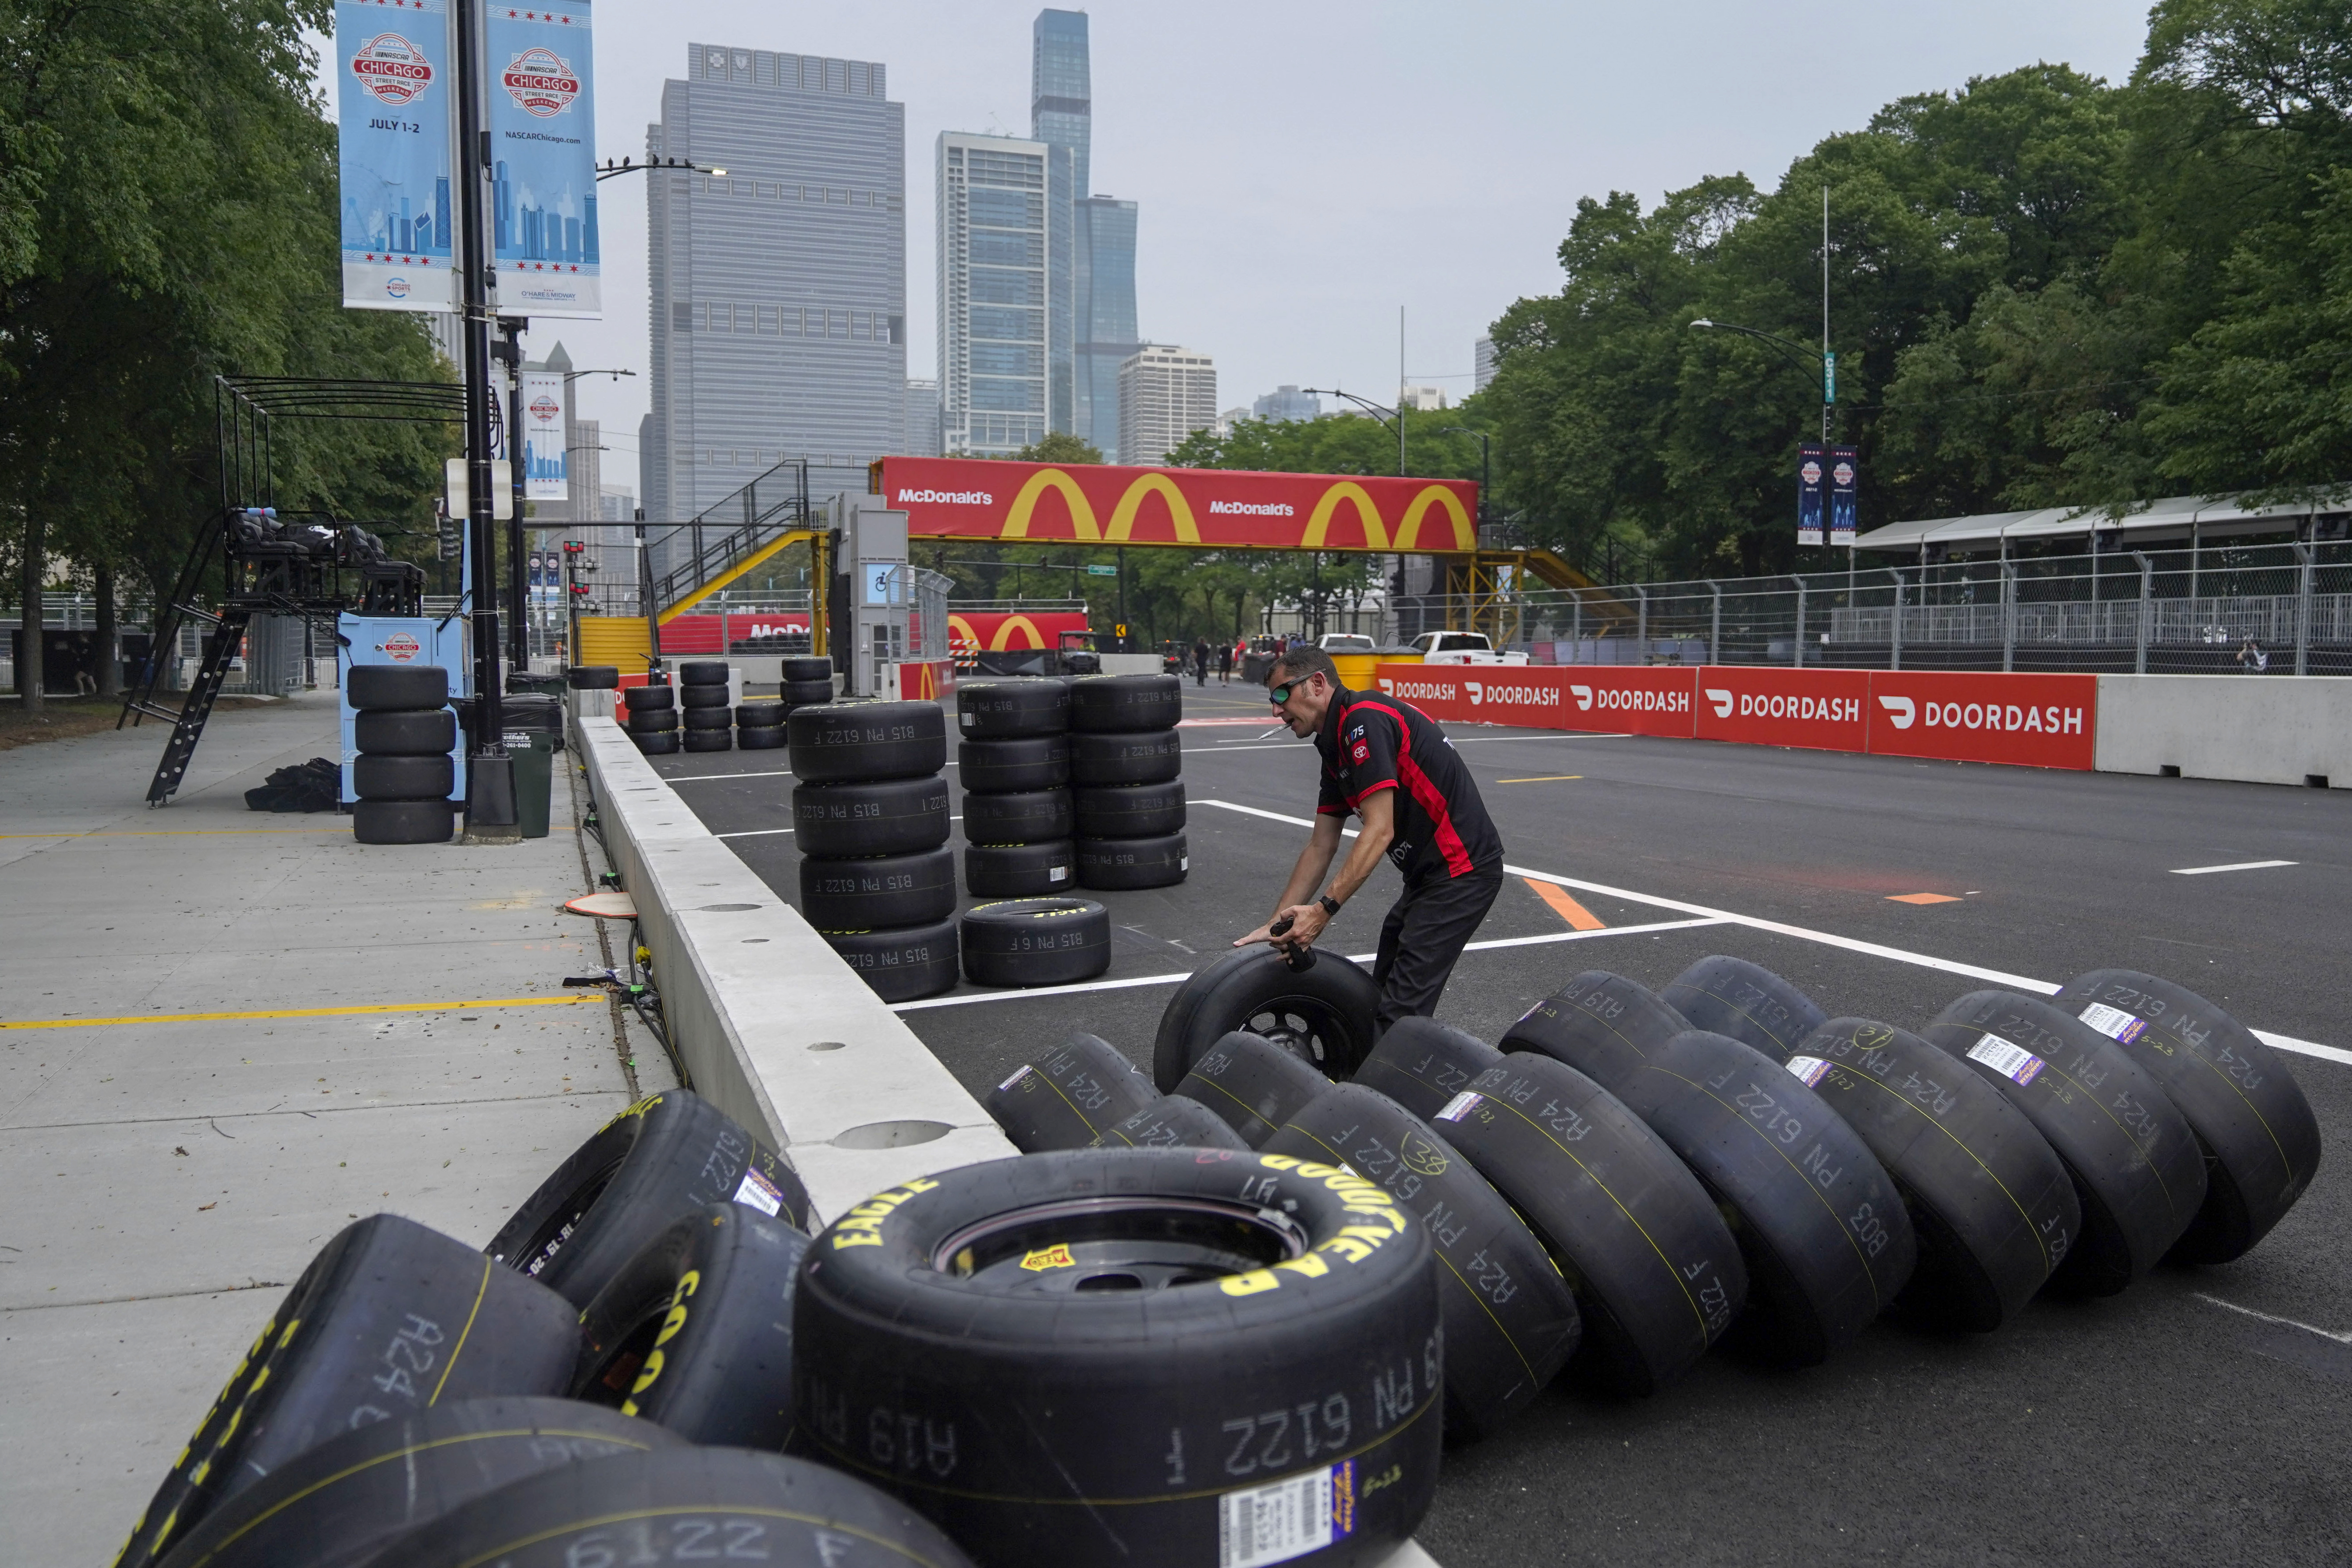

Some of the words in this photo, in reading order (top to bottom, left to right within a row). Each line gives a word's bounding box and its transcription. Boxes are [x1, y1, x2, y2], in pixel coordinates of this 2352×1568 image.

[381, 52, 409, 61] NASCAR
[361, 61, 424, 78] CHICAGO
[377, 87, 409, 95] WEEKEND
[512, 75, 571, 91] CHICAGO
[369, 119, 399, 131] JULY
[402, 122, 420, 133] 1-2
[505, 131, 580, 144] NASCARChicago.com
[1825, 357, 1834, 398] C311
[898, 488, 993, 504] McDonald's
[1210, 501, 1294, 516] McDonald's
[1396, 682, 1456, 701] DOORDASH
[1487, 685, 1559, 706] DOORDASH
[1598, 689, 1689, 712] DOORDASH
[1741, 694, 1859, 722] DOORDASH
[1925, 702, 2082, 734] DOORDASH
[826, 729, 859, 744] 6122
[866, 727, 884, 741] PN
[891, 725, 915, 740] B15
[1352, 725, 1364, 739] 75
[801, 805, 825, 818] 6122
[830, 805, 847, 818] PN
[853, 802, 880, 818] B15
[1101, 855, 1112, 865] PN
[1116, 854, 1134, 864] B15
[825, 879, 855, 892] 6122
[862, 877, 880, 891] PN
[887, 874, 912, 889] B15
[1010, 938, 1018, 950] F
[1022, 937, 1030, 950] 6
[1038, 936, 1055, 949] PN
[1061, 932, 1083, 947] B15
[881, 951, 899, 965] PN
[905, 947, 929, 963] B15
[2079, 982, 2102, 996] F
[2104, 984, 2167, 1018] 6122
[1972, 1008, 1996, 1025] F
[1999, 1015, 2064, 1056] 6122
[2116, 1020, 2130, 1034] EAGLE
[2172, 1014, 2211, 1048] PN
[2011, 1057, 2027, 1073] EAGLE
[2019, 1060, 2043, 1084] GOODYEAR
[2068, 1053, 2108, 1090] PN
[1708, 1069, 1735, 1090] F
[1067, 1072, 1111, 1110] A24
[1503, 1076, 1540, 1105] PN
[1538, 1097, 1593, 1142] A24
[1735, 1082, 1802, 1144] 6122
[1331, 1125, 1360, 1145] F
[701, 1130, 745, 1192] 6122
[1355, 1137, 1423, 1201] 6122
[1803, 1143, 1843, 1189] PN
[832, 1175, 941, 1250] EAGLE
[1218, 1153, 1409, 1298] GOODYEAR
[1422, 1200, 1468, 1248] PN
[1849, 1202, 1889, 1258] B03
[1029, 1251, 1063, 1268] AERO
[1466, 1248, 1519, 1304] A24
[1683, 1258, 1709, 1281] F
[1370, 1357, 1416, 1432] PN
[869, 1408, 958, 1478] A19
[1221, 1391, 1352, 1477] 6122
[1161, 1427, 1190, 1486] F
[565, 1521, 773, 1568] 6122
[813, 1531, 854, 1568] F
